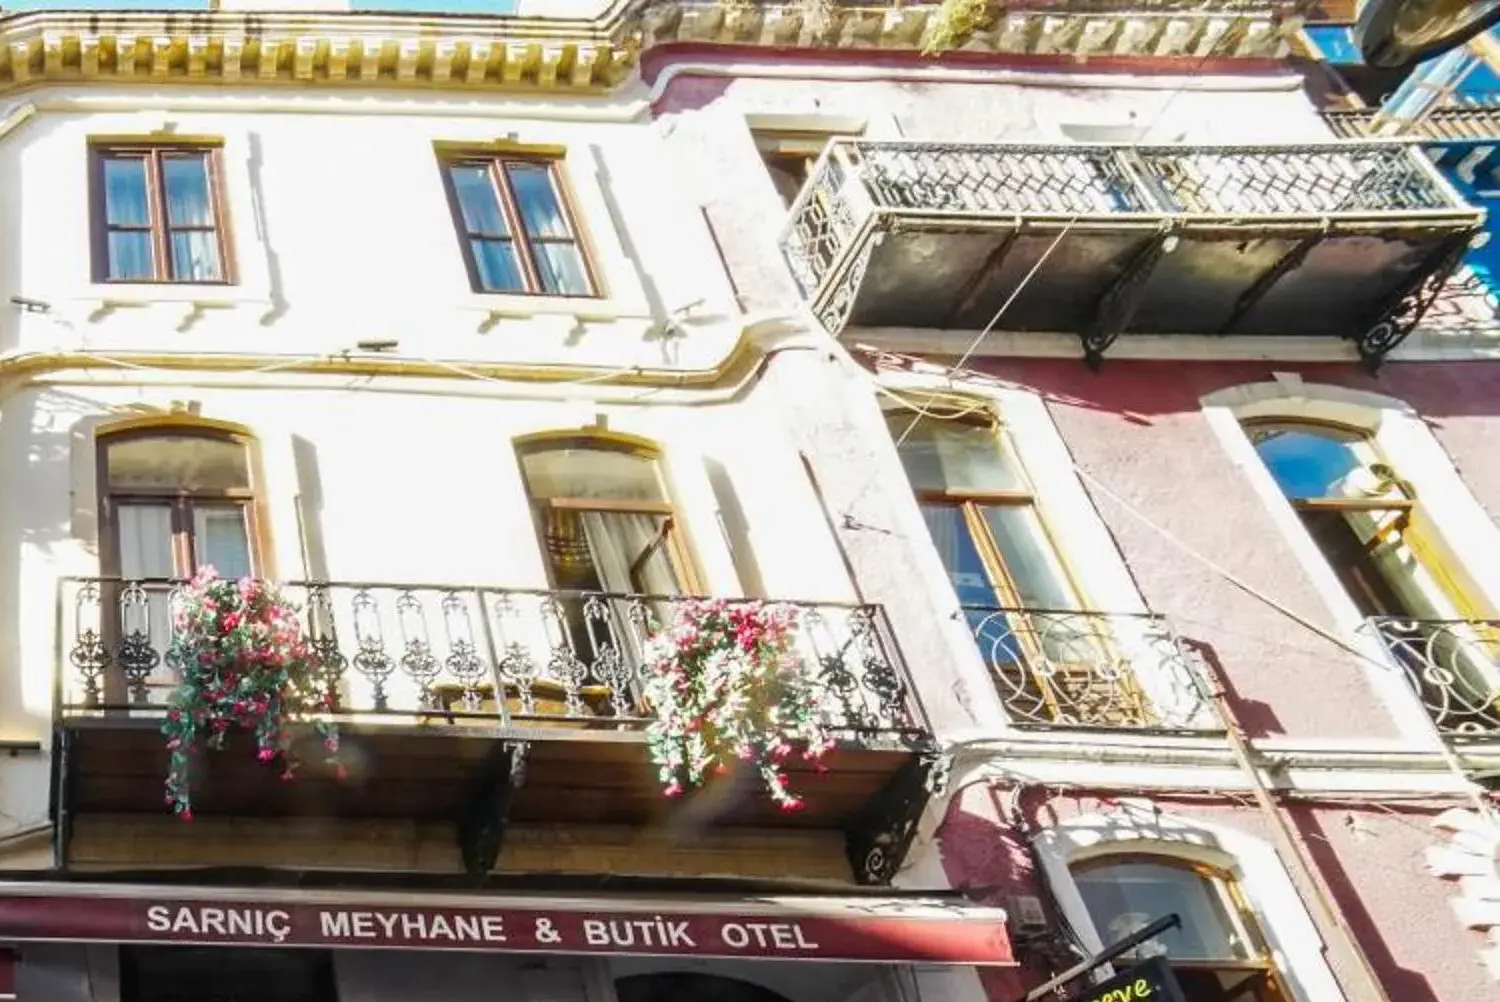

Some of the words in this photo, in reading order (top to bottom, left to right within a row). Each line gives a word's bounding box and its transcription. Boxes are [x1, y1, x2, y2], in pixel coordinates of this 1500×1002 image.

[147, 905, 292, 942] SARNIÇ
[319, 911, 507, 941] MEYHANE
[534, 917, 562, 943] &
[583, 915, 696, 947] BUTİK
[721, 922, 819, 950] OTEL
